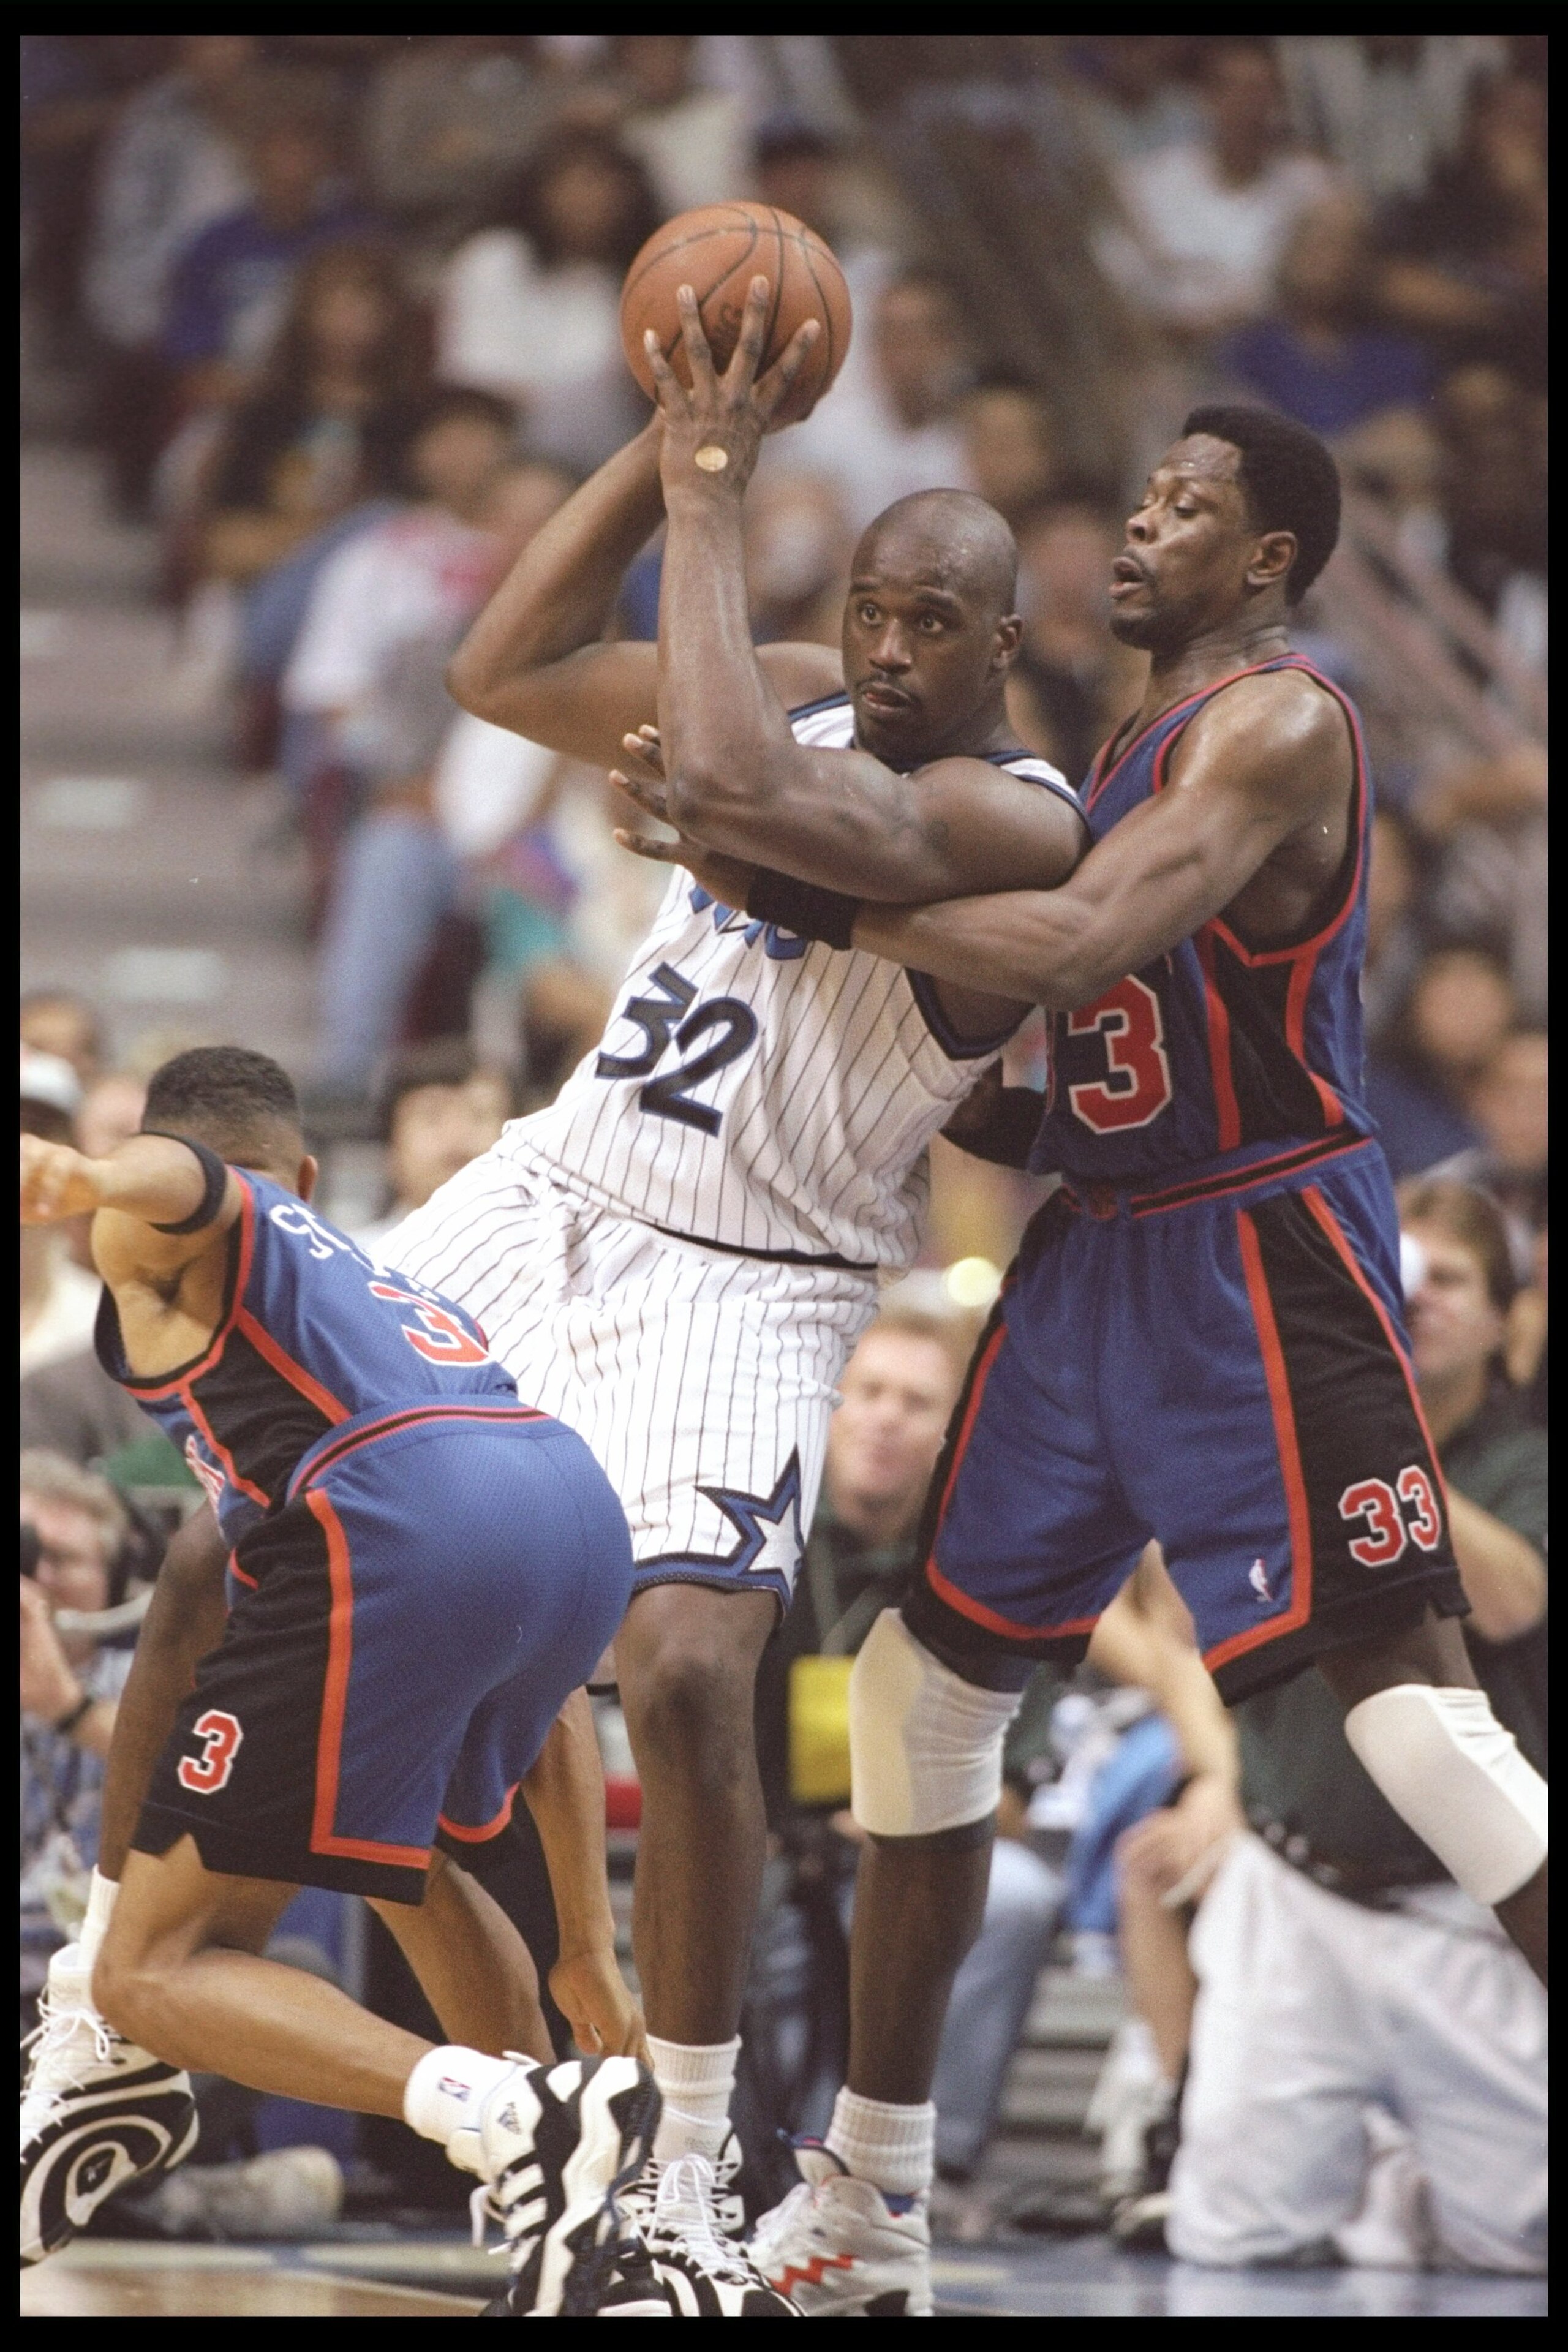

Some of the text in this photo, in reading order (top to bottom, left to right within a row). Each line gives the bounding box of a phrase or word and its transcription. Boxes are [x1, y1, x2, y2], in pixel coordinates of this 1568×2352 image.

[595, 962, 758, 1139] 32
[368, 1280, 489, 1366] 3
[1338, 1464, 1441, 1568] 33
[177, 1709, 244, 1795] 3
